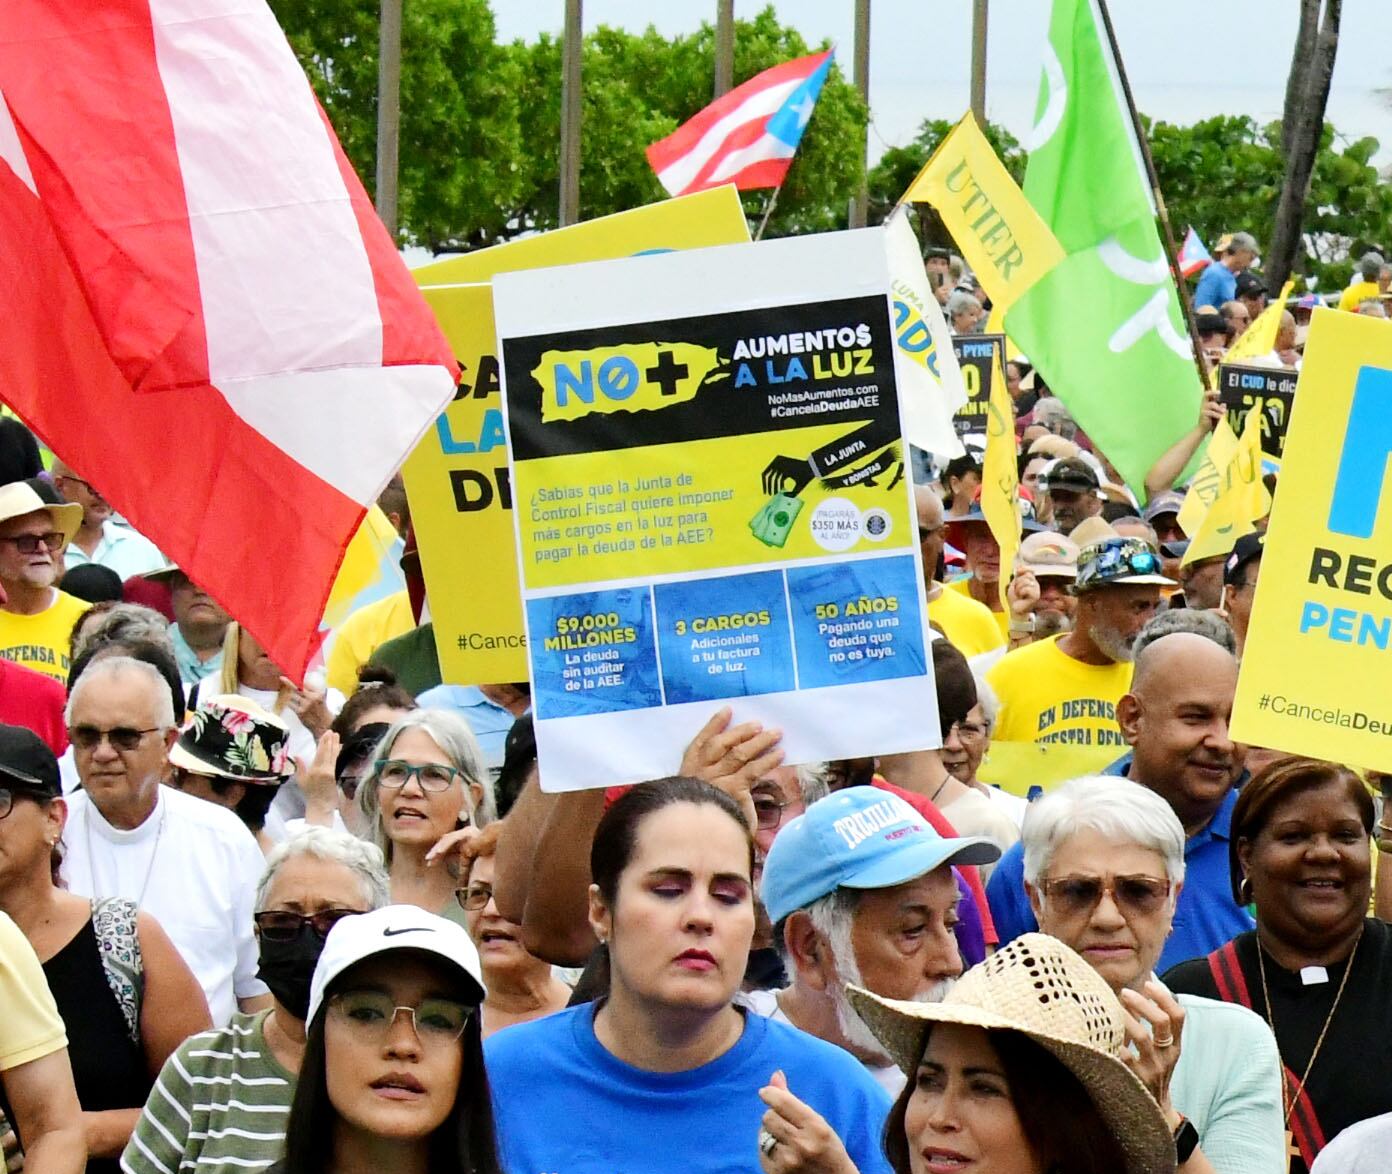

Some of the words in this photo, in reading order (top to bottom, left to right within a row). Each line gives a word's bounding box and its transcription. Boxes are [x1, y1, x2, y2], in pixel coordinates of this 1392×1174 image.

[945, 156, 1023, 281] UTIER
[734, 364, 757, 389] A
[767, 357, 808, 386] LA
[813, 348, 875, 380] LUZ
[1229, 373, 1239, 387] El
[1241, 374, 1264, 389] CUD
[1266, 378, 1276, 391] le
[767, 384, 880, 407] NoMasAumentos.com
[771, 395, 881, 418] #CancelaDeudaAEE
[824, 453, 839, 466] LA
[838, 440, 867, 460] JUNTA
[589, 484, 613, 500] que
[618, 480, 629, 493] la
[634, 475, 672, 491] Junta
[676, 473, 693, 486] de
[531, 505, 581, 522] Control
[586, 500, 626, 516] Fiscal
[631, 495, 674, 512] quiere
[679, 488, 735, 508] imponer
[565, 520, 612, 540] cargos
[617, 519, 633, 532] en
[637, 515, 648, 530] la
[653, 512, 673, 528] luz
[678, 511, 708, 529] para
[812, 520, 834, 531] $350
[535, 545, 572, 564] pagar
[577, 541, 588, 557] la
[593, 536, 636, 554] deuda
[640, 535, 656, 549] de
[661, 532, 672, 546] la
[816, 604, 839, 620] 50
[845, 596, 899, 617] AÑOS
[675, 621, 687, 636] 3
[692, 610, 771, 633] CARGOS
[818, 620, 874, 637] Pagando
[876, 616, 900, 629] una
[544, 627, 637, 652] MILLONES
[690, 631, 760, 651] Adicionales
[828, 633, 867, 649] deuda
[869, 631, 893, 647] que
[565, 652, 580, 666] La
[583, 647, 620, 664] deuda
[692, 653, 700, 664] a
[703, 651, 716, 664] tu
[718, 646, 761, 662] factura
[829, 650, 845, 664] no
[847, 649, 863, 662] es
[563, 664, 581, 679] sin
[584, 660, 625, 678] auditar
[708, 661, 724, 675] de
[565, 677, 580, 692] de
[582, 676, 594, 690] la
[1038, 706, 1056, 732] EN
